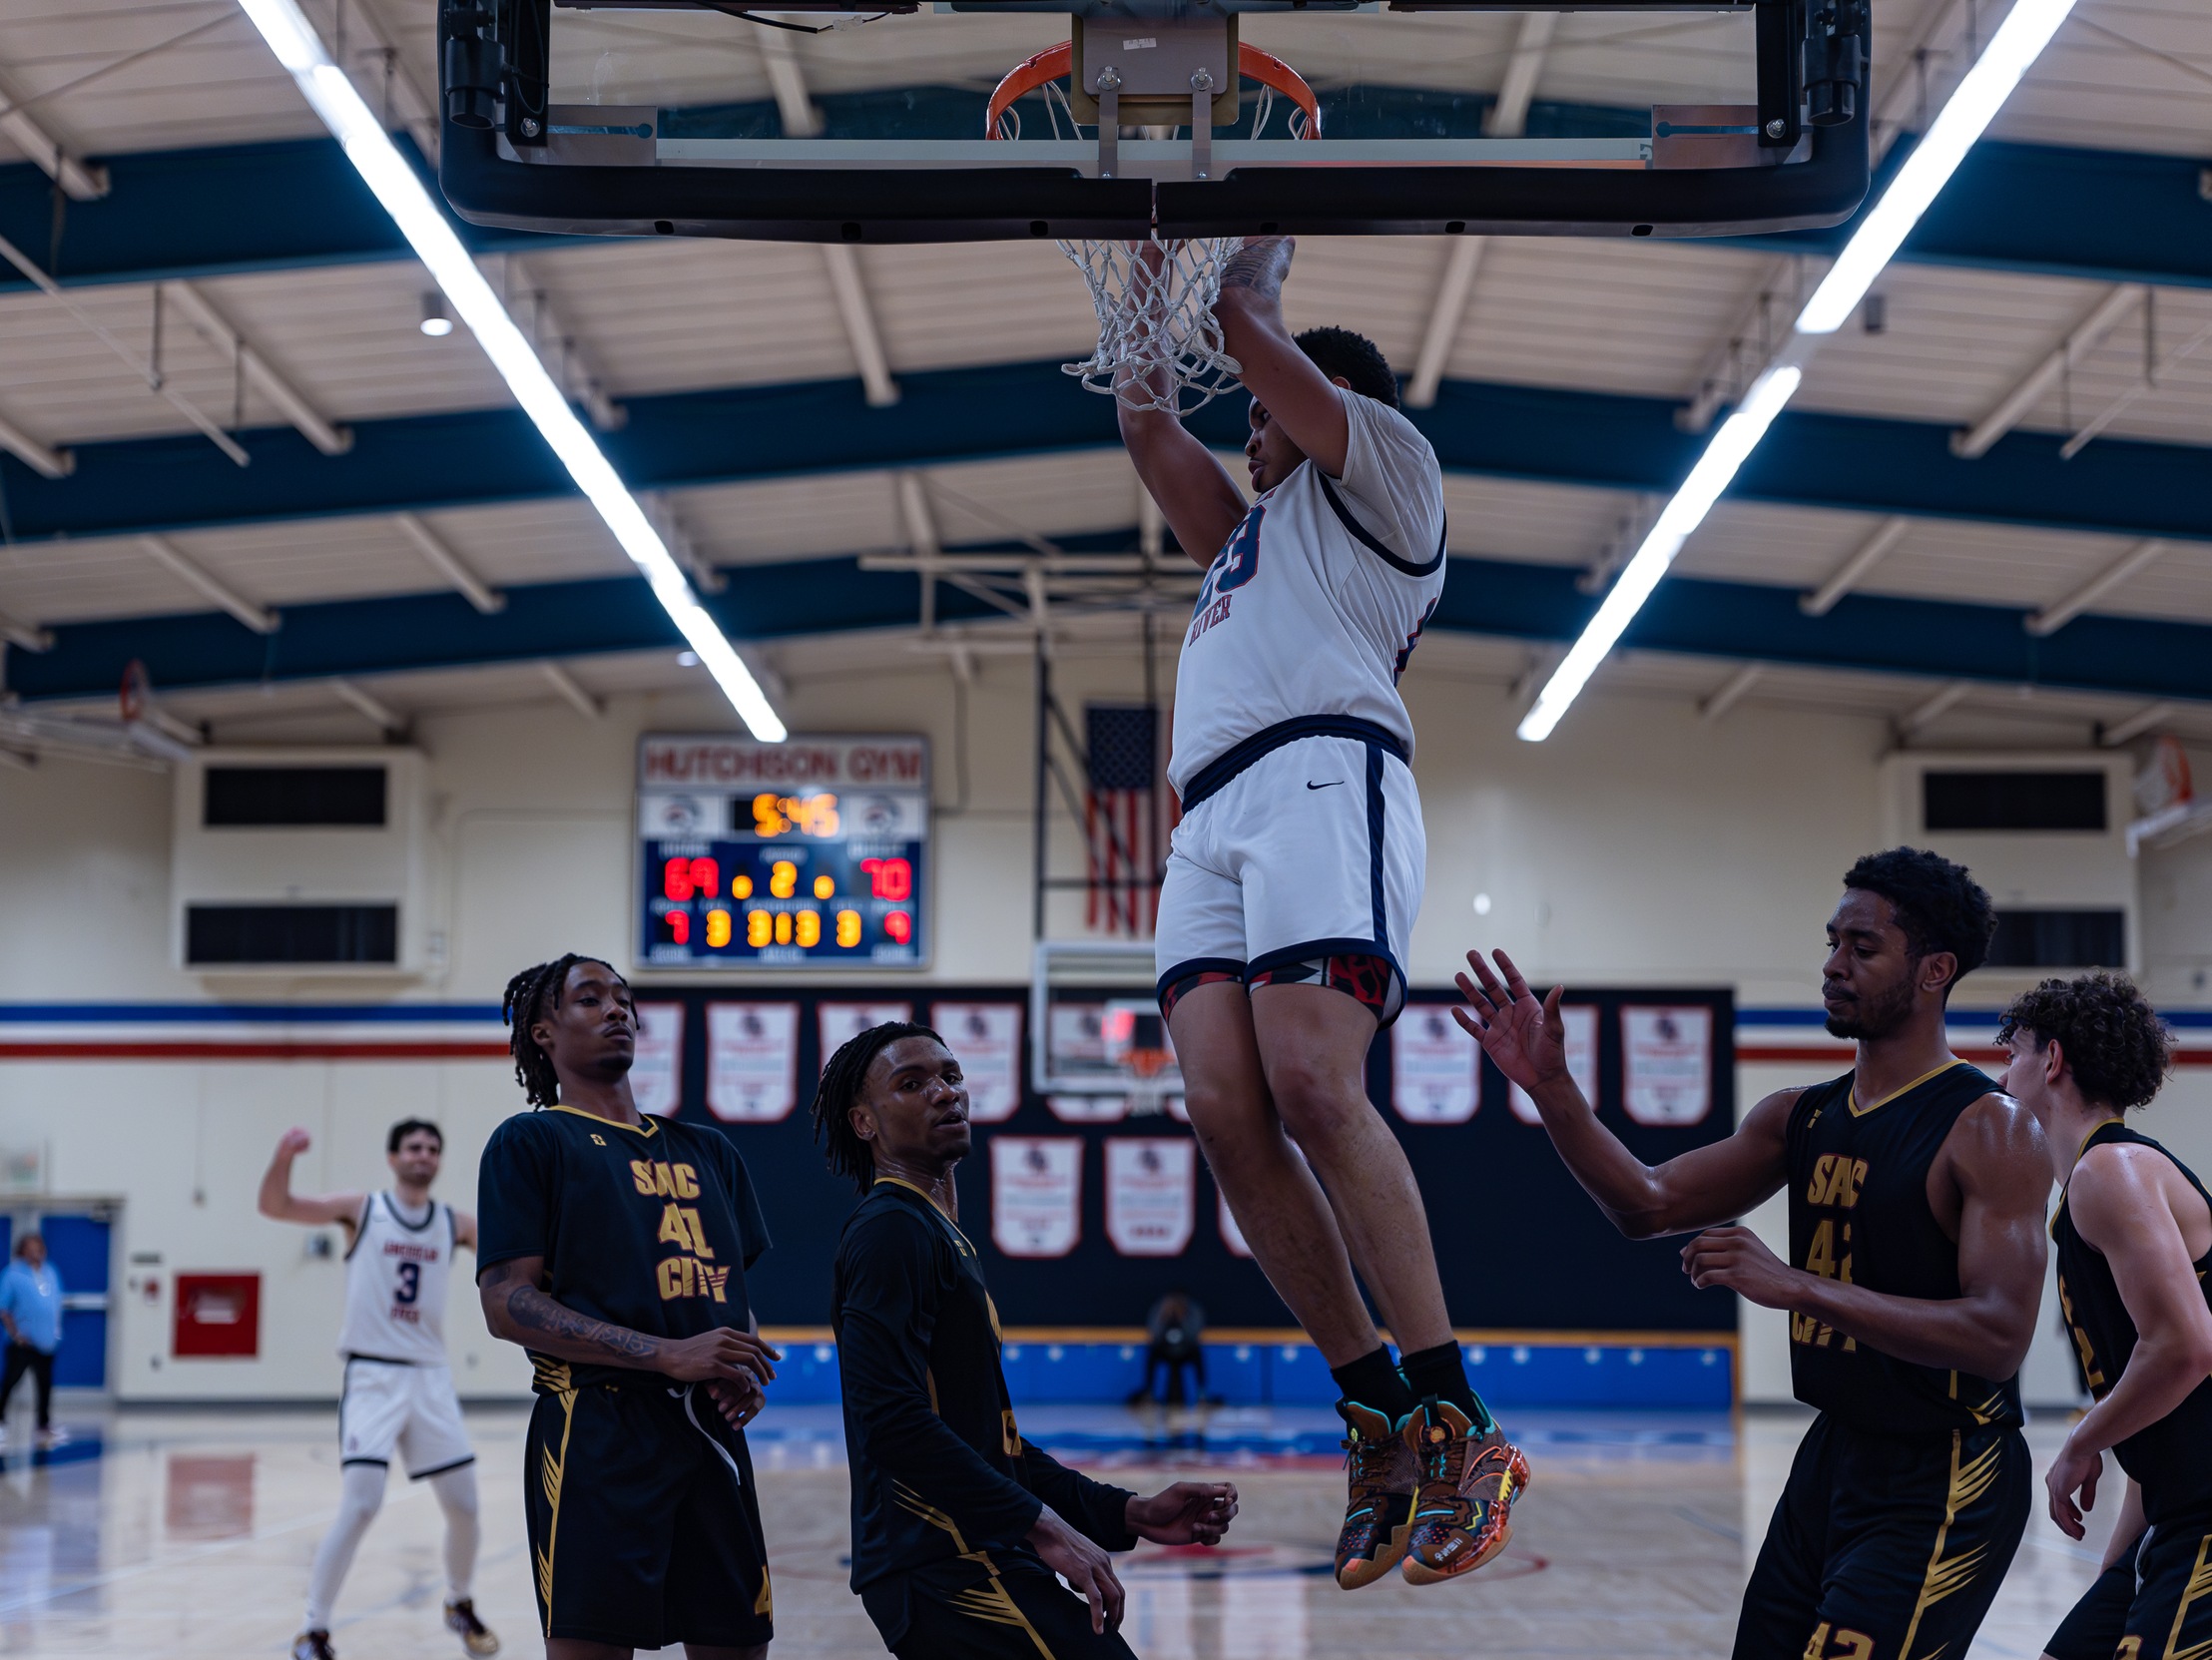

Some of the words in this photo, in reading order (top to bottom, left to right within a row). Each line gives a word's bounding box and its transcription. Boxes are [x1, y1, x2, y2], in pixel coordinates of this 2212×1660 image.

[1189, 594, 1233, 647] RIVER
[647, 747, 836, 781] HUTCHISON
[848, 747, 922, 781] GYM
[770, 860, 798, 898] 2
[860, 857, 911, 902] 70
[707, 909, 732, 947] 3
[836, 909, 861, 947] 3
[629, 1158, 702, 1200] SAC
[1807, 1153, 1870, 1210] SAC
[657, 1202, 716, 1261] 41
[394, 1261, 420, 1305] 3
[656, 1255, 732, 1304] CITY
